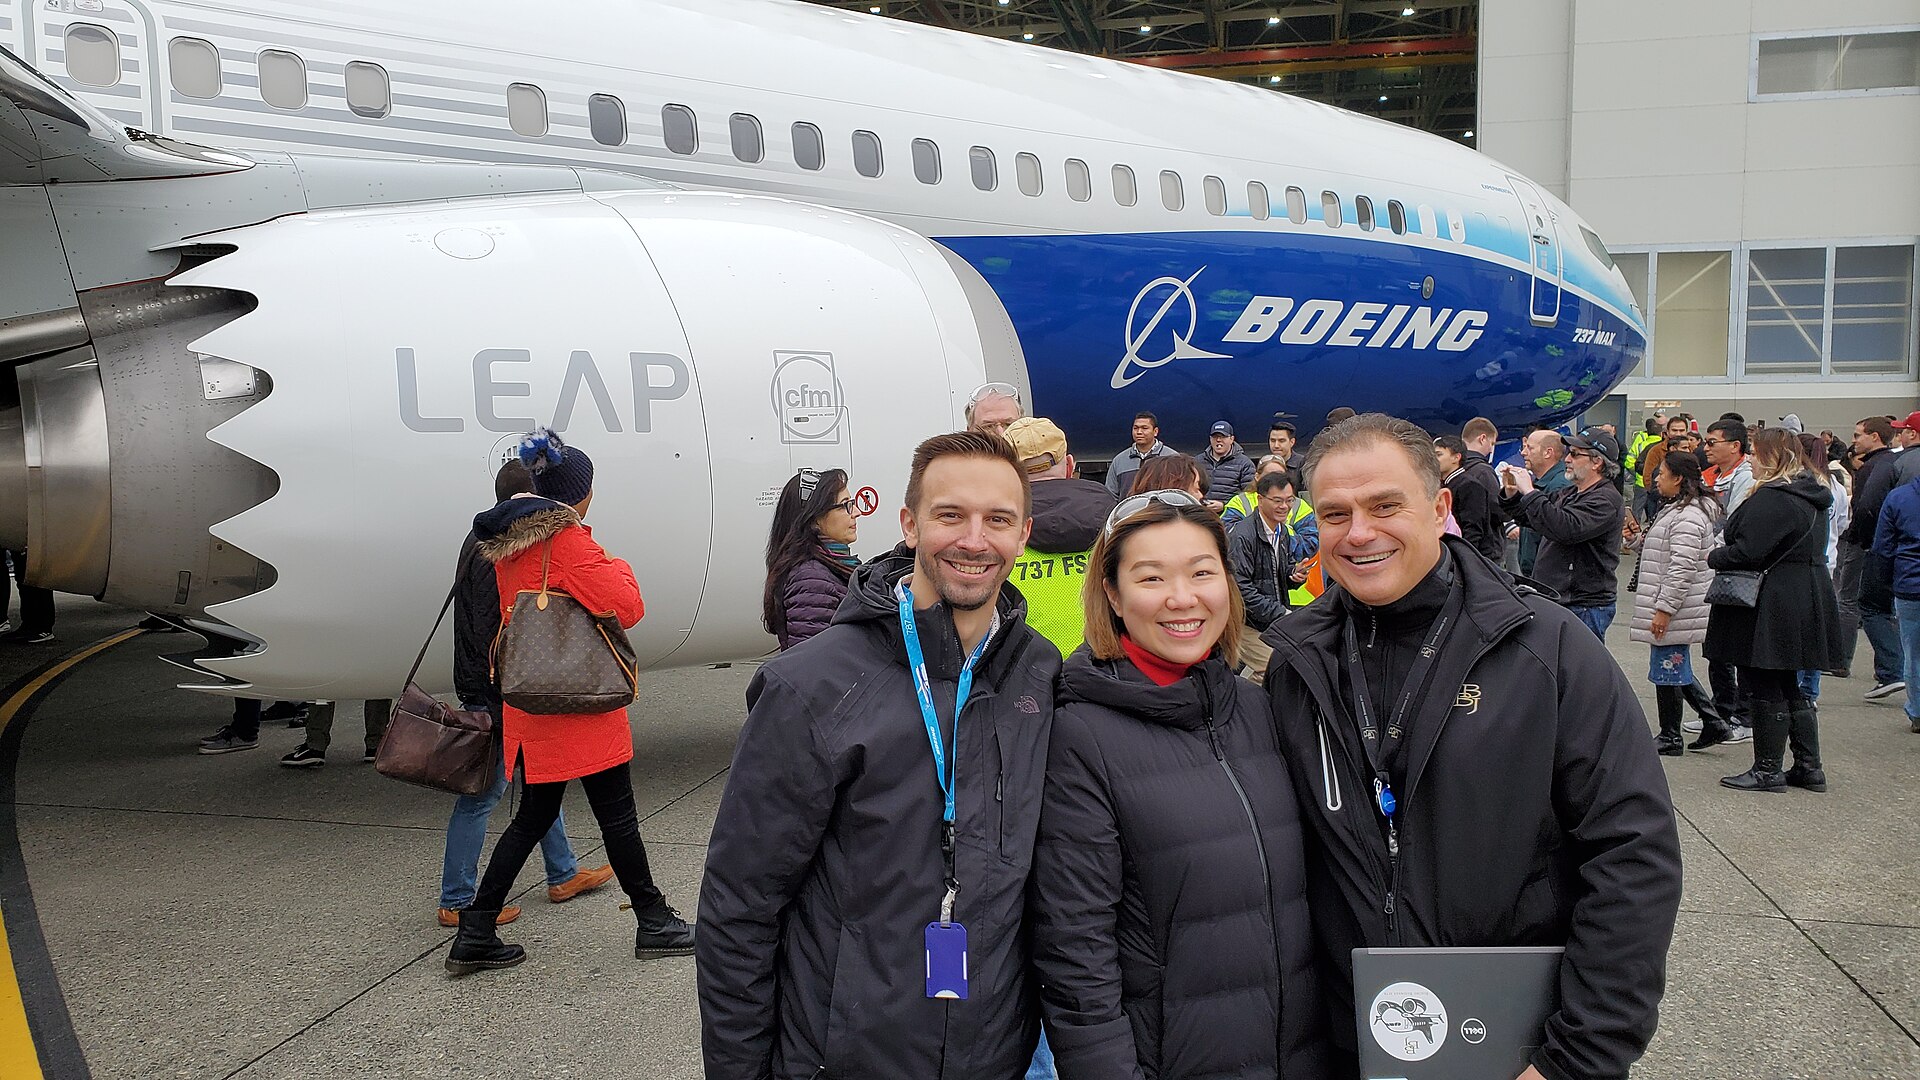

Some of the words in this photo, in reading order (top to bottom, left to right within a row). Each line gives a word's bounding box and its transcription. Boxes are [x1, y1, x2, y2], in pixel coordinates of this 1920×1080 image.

[1221, 295, 1489, 351] BOEING
[1572, 328, 1596, 344] 737
[1593, 330, 1617, 347] MAX
[395, 347, 690, 433] LEAP
[785, 384, 832, 407] cfm
[1015, 559, 1055, 581] 737
[1062, 554, 1091, 576] FS
[1463, 1027, 1484, 1035] DELL
